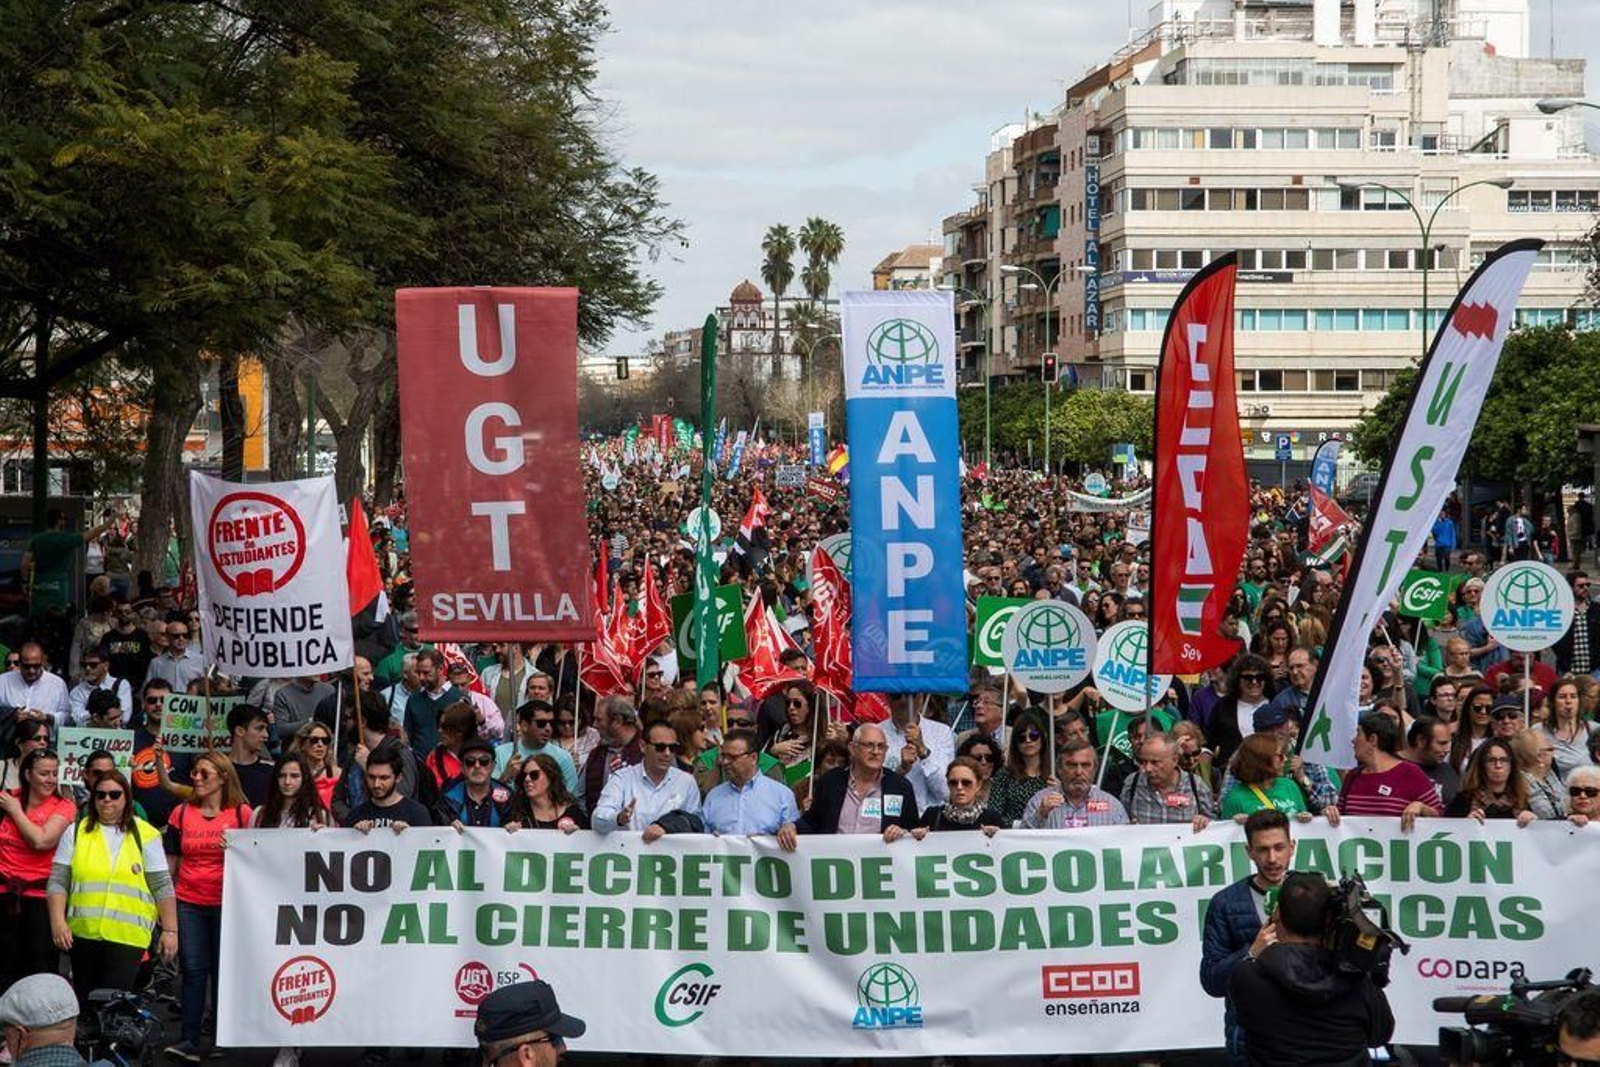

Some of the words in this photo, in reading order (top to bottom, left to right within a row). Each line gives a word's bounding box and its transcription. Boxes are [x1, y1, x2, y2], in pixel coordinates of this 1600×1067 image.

[1086, 172, 1099, 231] HOTEL
[1086, 241, 1098, 326] ALAZAR
[861, 363, 946, 385] ANPE
[458, 303, 526, 571] UGT
[1278, 436, 1289, 449] P
[215, 511, 286, 543] FRENTE
[876, 410, 937, 665] ANPE
[219, 541, 296, 566] ESTUDIANTES
[1411, 586, 1445, 602] CSIF
[213, 603, 324, 634] DEFIENDE
[431, 593, 580, 621] SEVILLA
[1491, 609, 1563, 627] ANPE
[232, 633, 338, 668] PÚBLICA
[1012, 648, 1086, 667] ANPE
[169, 697, 198, 714] CON
[305, 851, 391, 892] NO
[410, 850, 484, 891] AL
[504, 852, 792, 898] DECRETO
[811, 857, 896, 900] DE
[915, 832, 1514, 898] ESCOLARIACIÓN
[275, 904, 365, 945] NO
[380, 903, 458, 944] AL
[476, 903, 708, 950] CIERRE
[727, 909, 809, 953] DE
[824, 900, 1178, 956] UNIDADES
[279, 969, 325, 992] FRENTE
[1049, 969, 1134, 992] CCOO
[281, 988, 329, 1006] ESTUDIANTES
[668, 982, 721, 1006] CSIF
[852, 1006, 923, 1025] ANPE
[1045, 999, 1141, 1017] enseñanza
